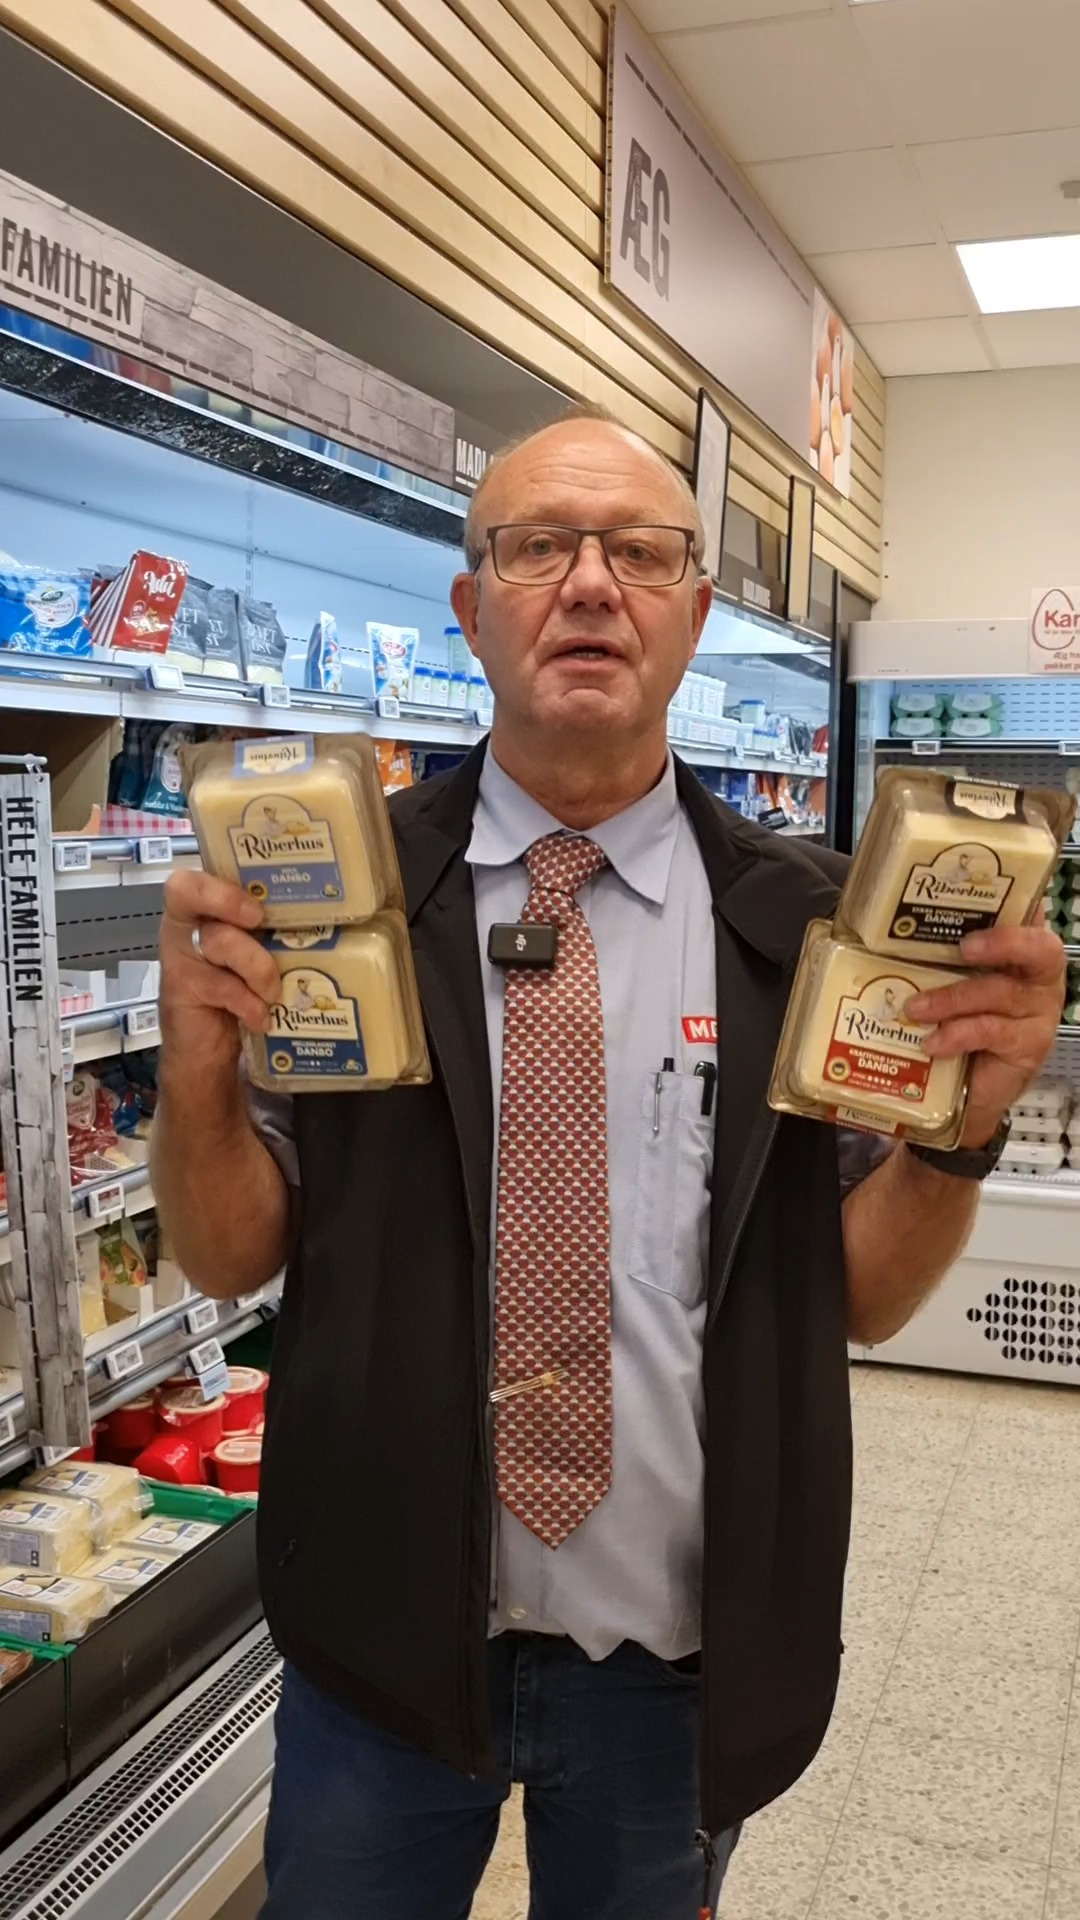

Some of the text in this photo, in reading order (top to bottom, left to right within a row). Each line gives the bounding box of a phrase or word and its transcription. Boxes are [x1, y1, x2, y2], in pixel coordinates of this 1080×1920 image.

[620, 137, 670, 302] ÆG
[2, 217, 132, 325] FAMILIEN
[237, 833, 325, 860] Riberhus
[7, 796, 43, 1001] HELE FAMILIEN
[915, 872, 998, 900] Riberhus
[270, 1003, 349, 1031] Riberhus
[296, 1046, 334, 1058] DANBO
[857, 1057, 899, 1076] DANBO
